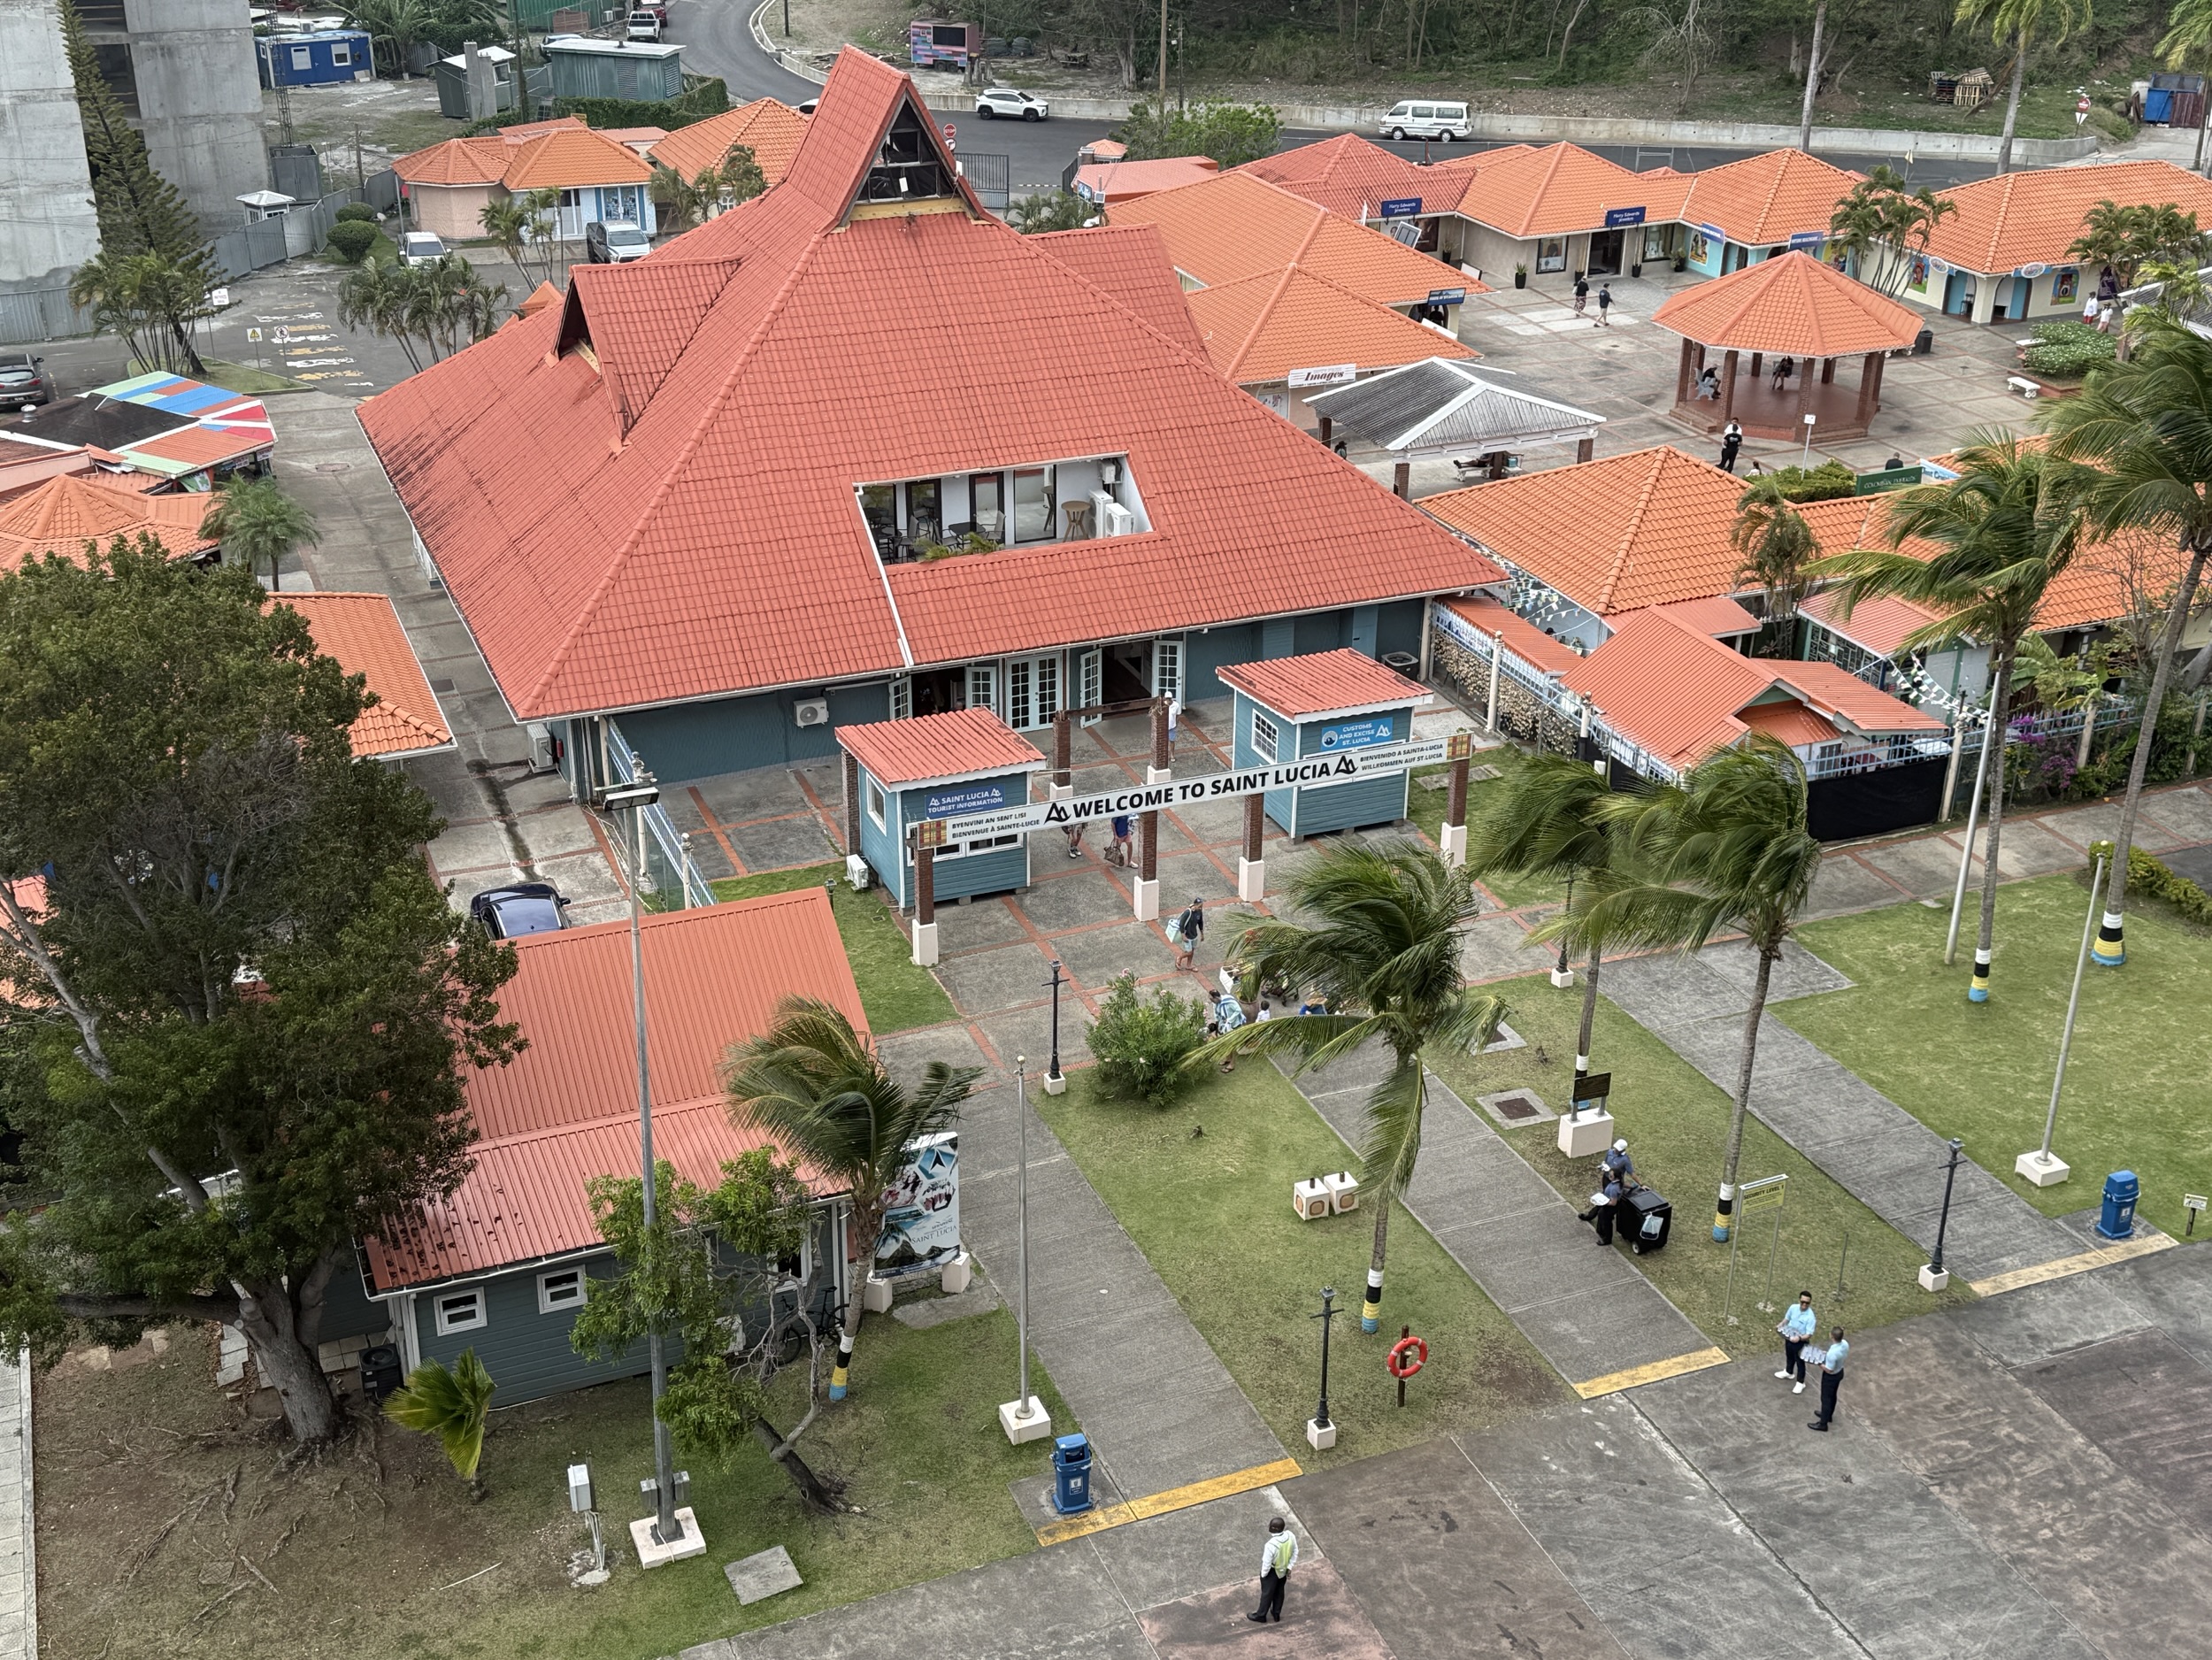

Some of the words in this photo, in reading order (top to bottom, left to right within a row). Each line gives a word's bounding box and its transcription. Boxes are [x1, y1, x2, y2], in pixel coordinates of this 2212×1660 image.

[1304, 371, 1345, 381] Images
[1342, 722, 1372, 732] CUSTOMS
[1353, 728, 1375, 737] EXCISE
[1360, 750, 1397, 763] BIENVENIDO
[1402, 743, 1444, 756] SAINTA-LUCIA
[1361, 759, 1403, 772] WILLKOMMEN
[941, 795, 965, 804] SAINT
[966, 791, 990, 800] LUCIA
[1072, 787, 1173, 818] WELCOME
[1179, 782, 1205, 800] TO
[1210, 772, 1270, 795] SAINT
[1274, 762, 1331, 785] LUCIA
[927, 803, 956, 814] TOURIST
[956, 796, 1003, 810] INFORMATION
[951, 818, 984, 829] BYENVINI
[996, 814, 1013, 823] SENT
[951, 828, 989, 839] BIENVENUE
[996, 818, 1040, 832] SAINTE-LUCIE
[911, 1233, 934, 1244] SAINT
[936, 1225, 957, 1237] LUCIA
